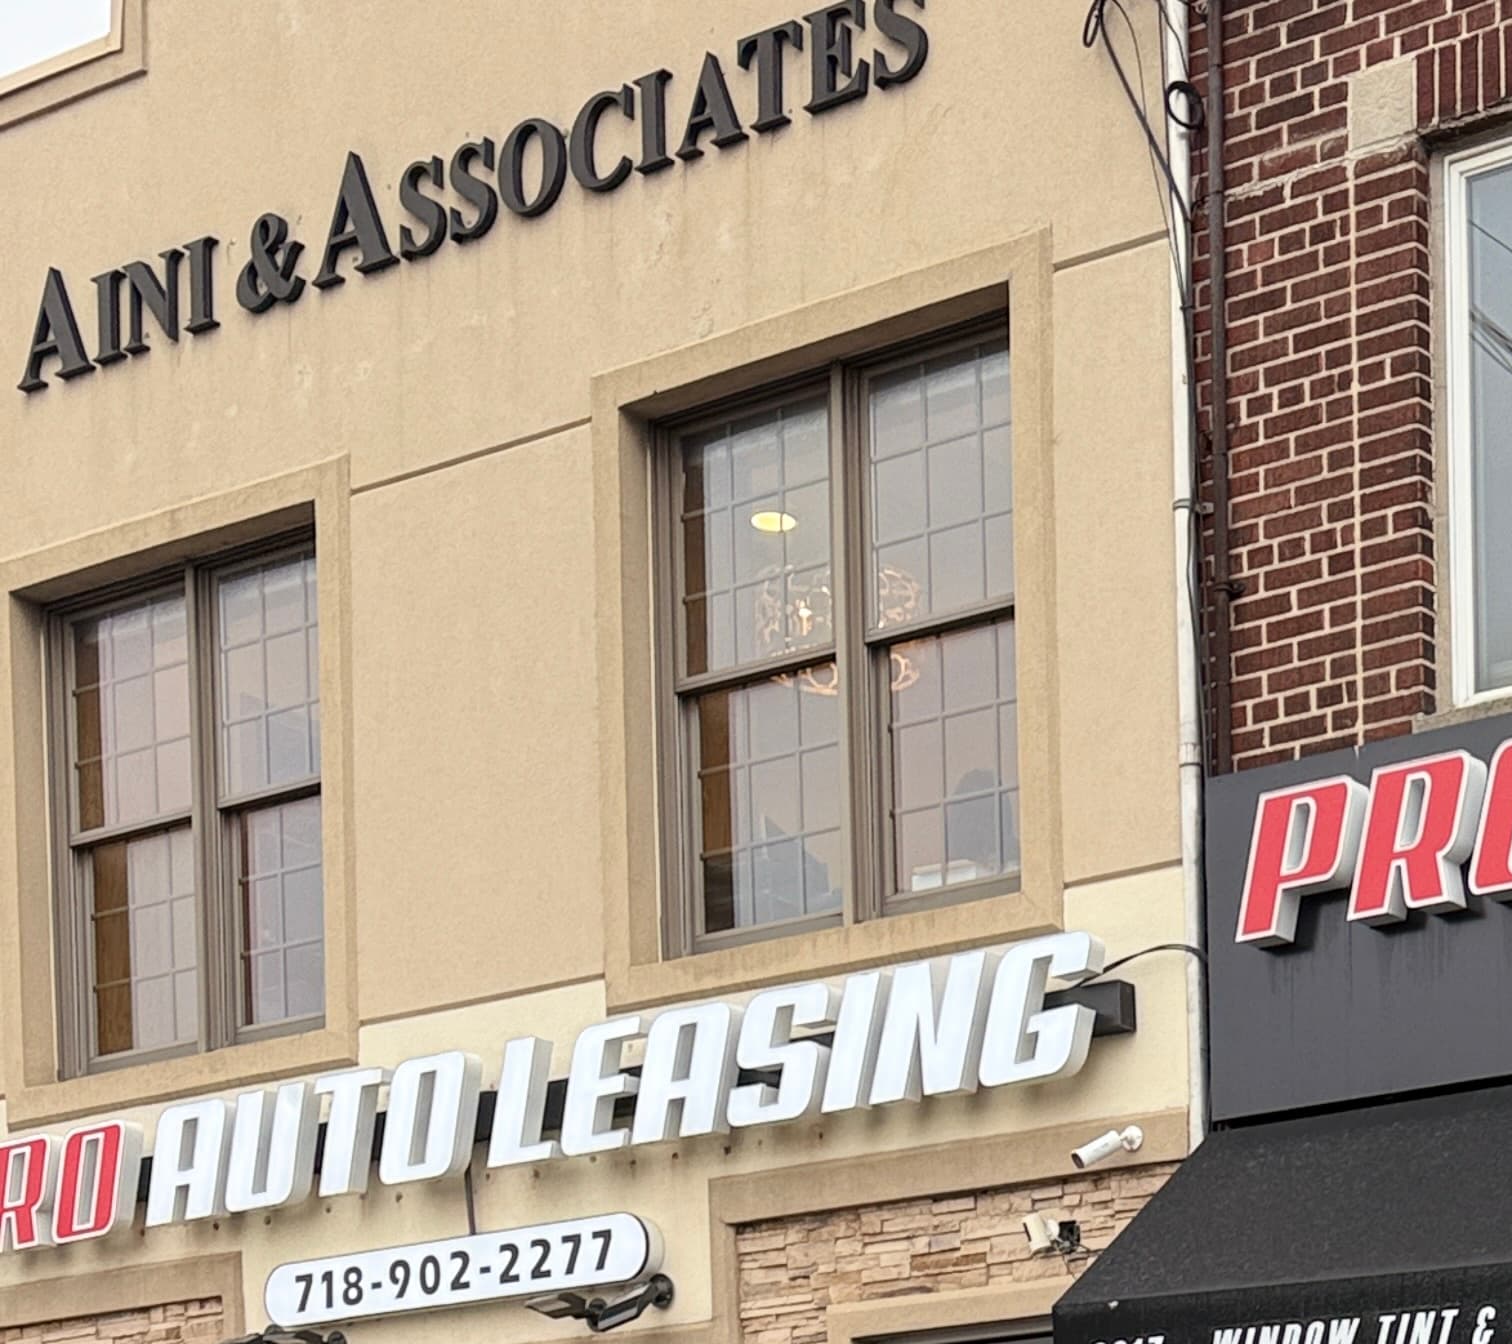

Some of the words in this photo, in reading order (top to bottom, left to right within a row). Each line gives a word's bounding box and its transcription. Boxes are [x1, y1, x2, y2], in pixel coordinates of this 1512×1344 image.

[236, 212, 305, 313] &
[312, 0, 930, 288] ASSOCIATES
[145, 1050, 482, 1227] AUTO
[487, 931, 1104, 1168] LEASING
[295, 1229, 613, 1313] 718-902-2277
